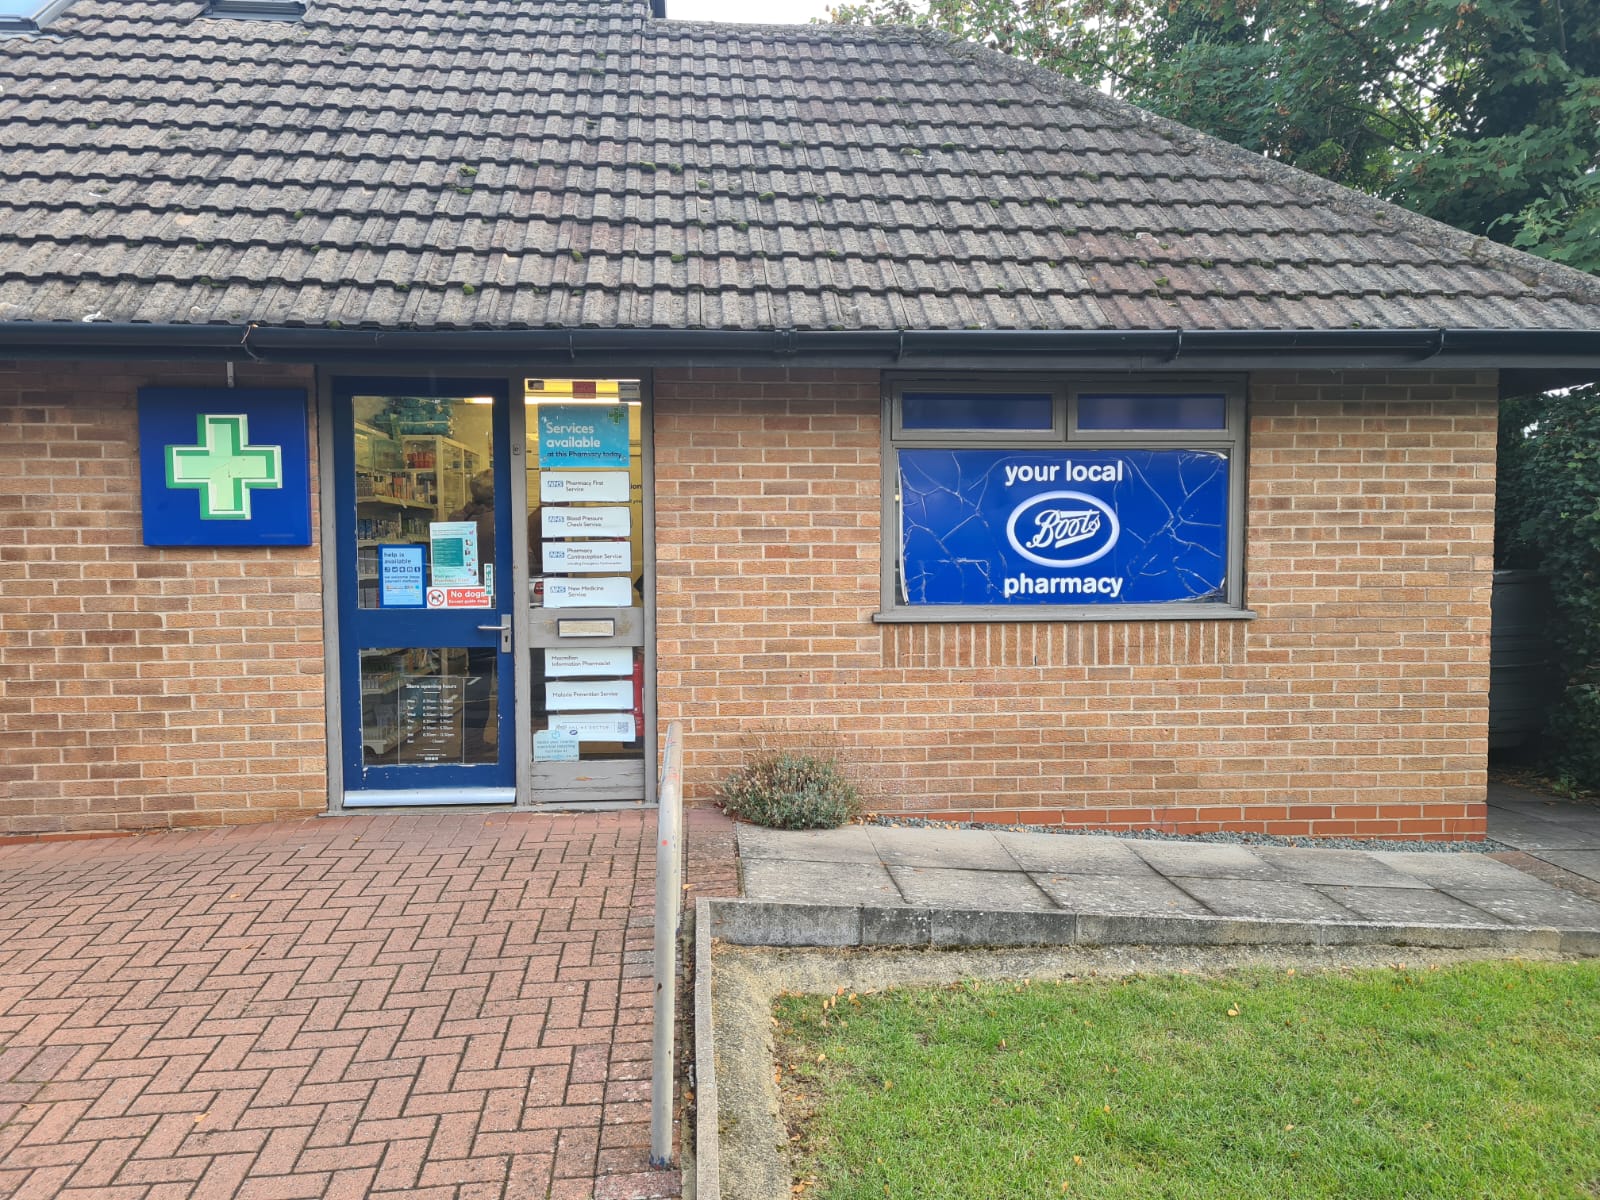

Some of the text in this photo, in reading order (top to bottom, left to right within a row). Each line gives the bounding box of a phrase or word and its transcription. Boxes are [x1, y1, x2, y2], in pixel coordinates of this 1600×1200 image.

[546, 422, 594, 434] Services
[546, 436, 600, 448] available
[569, 451, 600, 459] Pharmacy
[602, 451, 622, 459] today
[1005, 460, 1123, 487] your local
[548, 515, 565, 523] NHS
[1026, 509, 1101, 549] Boots
[1004, 573, 1123, 598] pharmacy
[450, 589, 486, 599] No dogs
